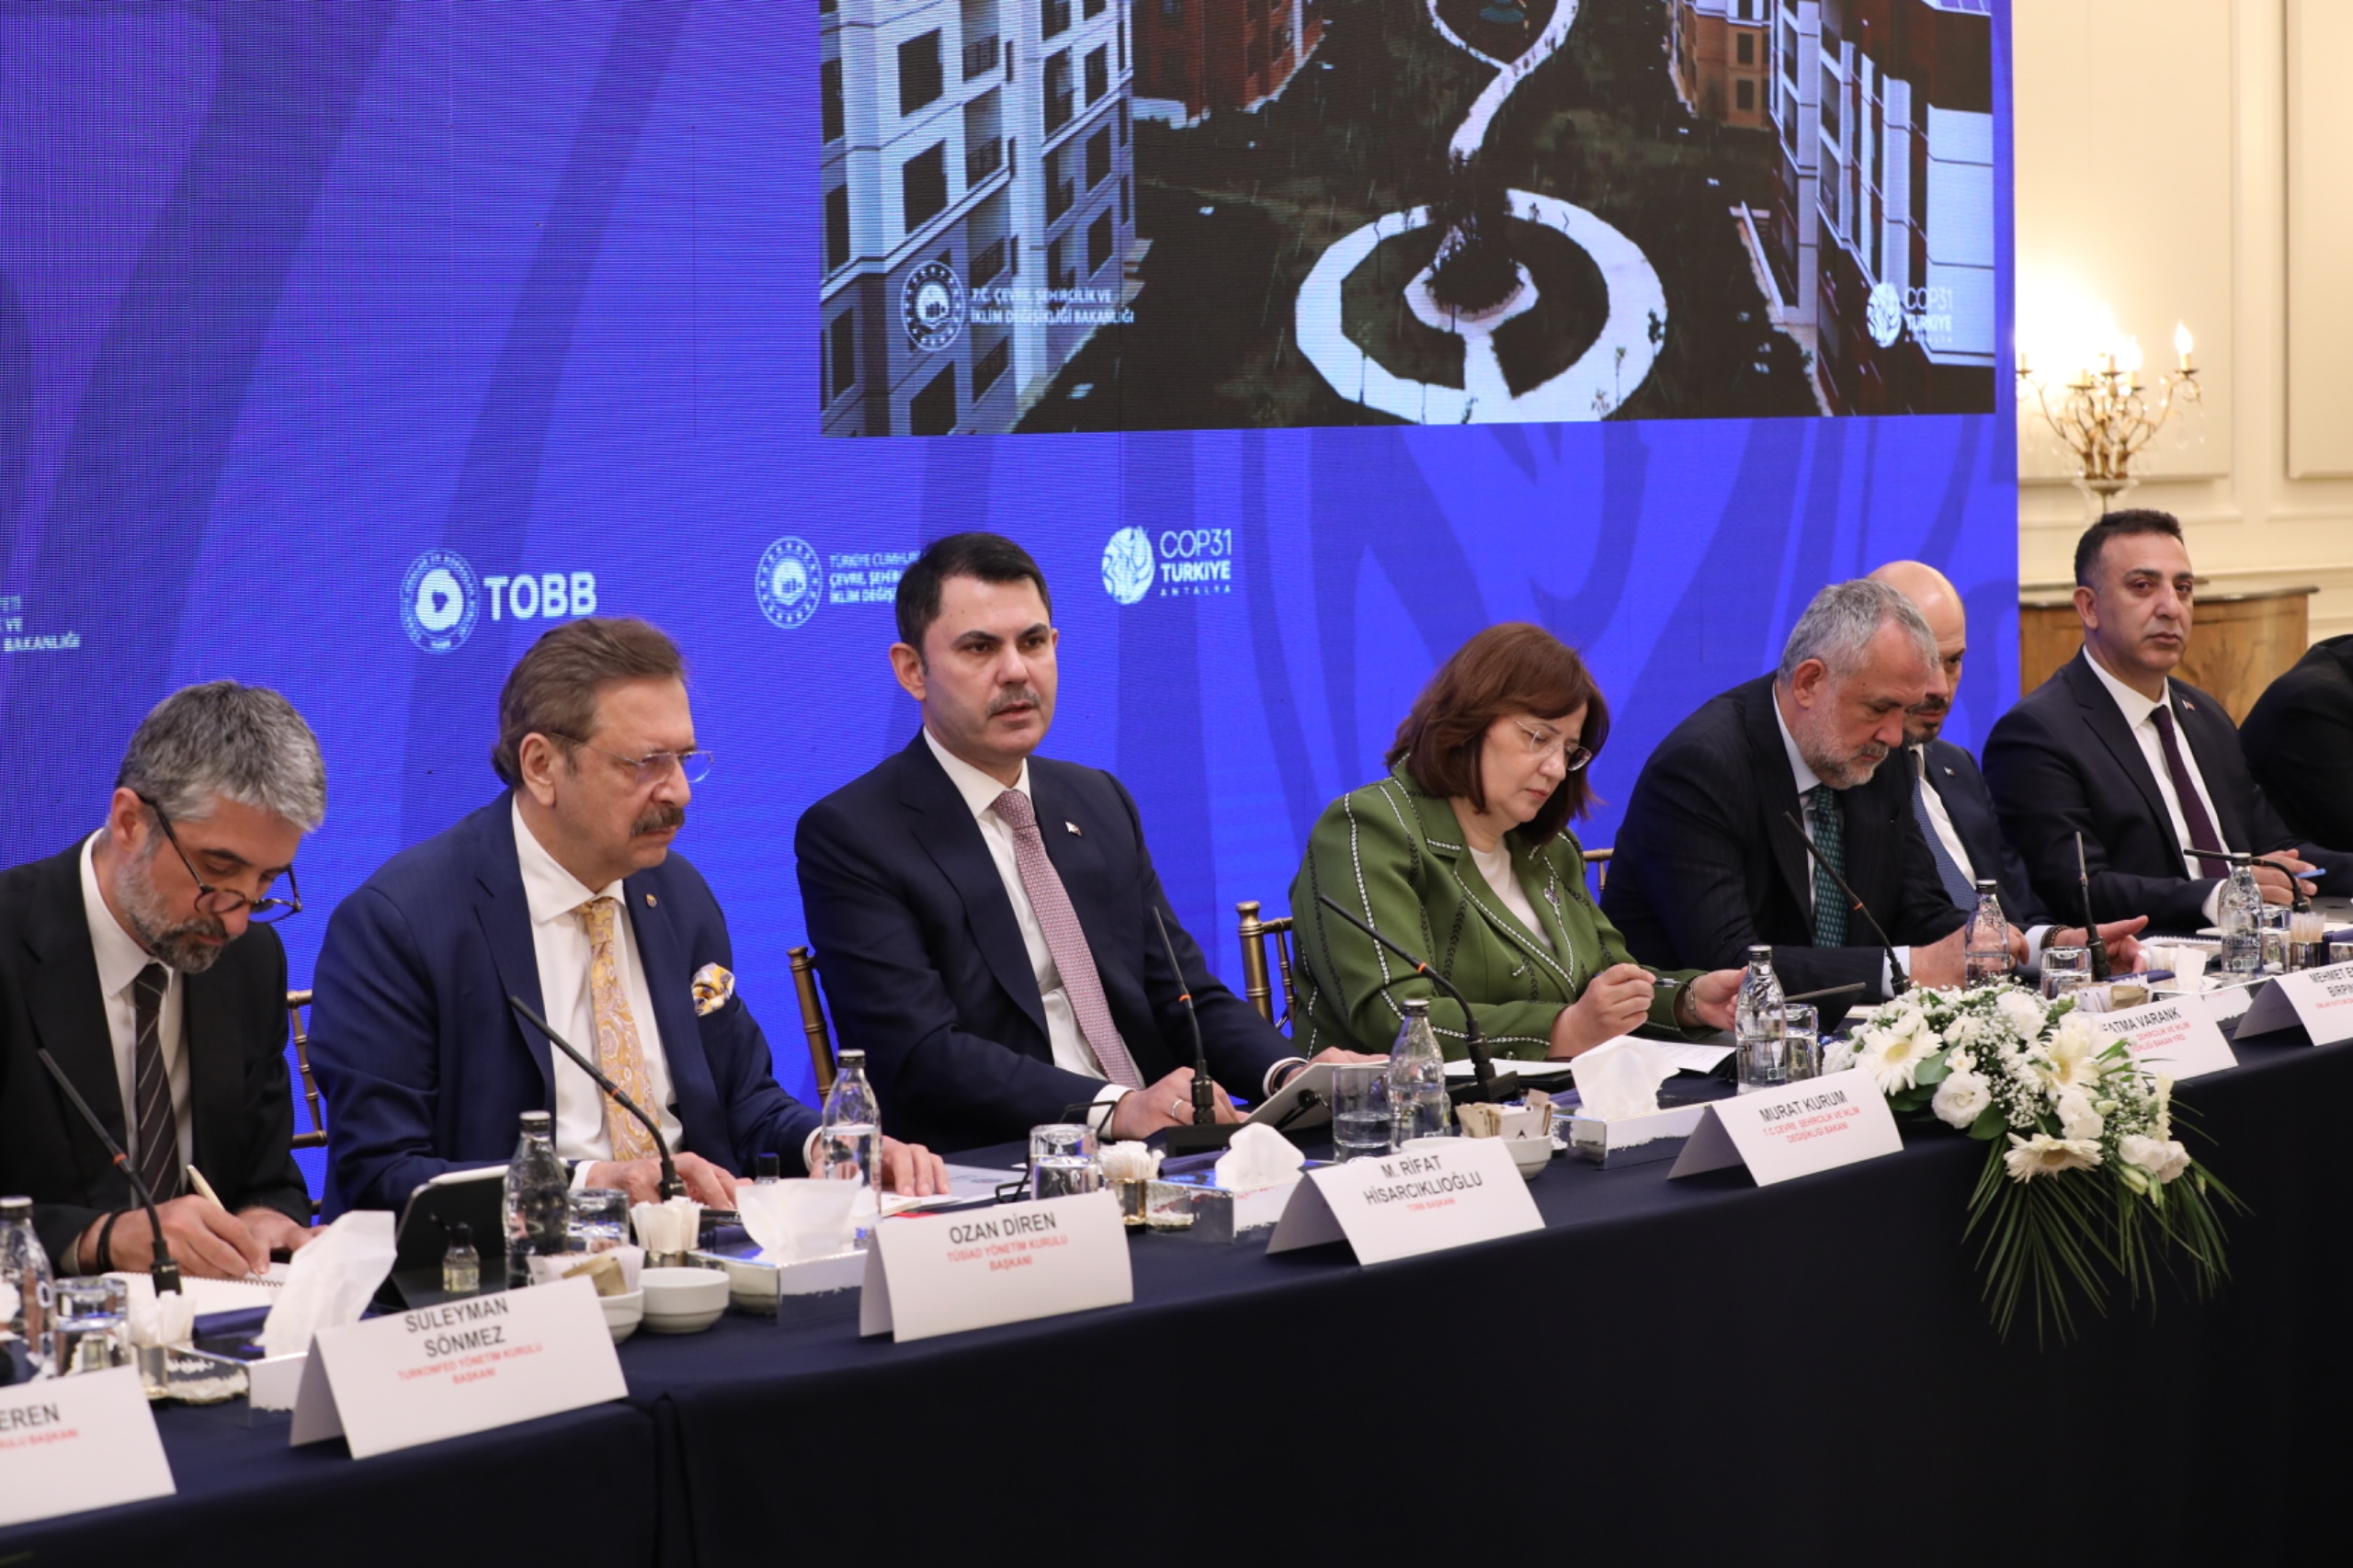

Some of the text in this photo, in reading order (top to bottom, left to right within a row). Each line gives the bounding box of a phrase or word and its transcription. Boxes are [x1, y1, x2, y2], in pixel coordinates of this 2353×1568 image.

[1159, 528, 1233, 559] COP31
[483, 572, 597, 621] TOBB
[2135, 1006, 2182, 1028] VARANK
[1759, 1090, 1848, 1121] MURAT KURUM
[1381, 1155, 1441, 1178] M. RİFAT
[1363, 1171, 1483, 1206] HİSARCIKLIOĞLU
[949, 1211, 1057, 1244] OZAN DİREN
[424, 1324, 506, 1358] SÖNMEZ
